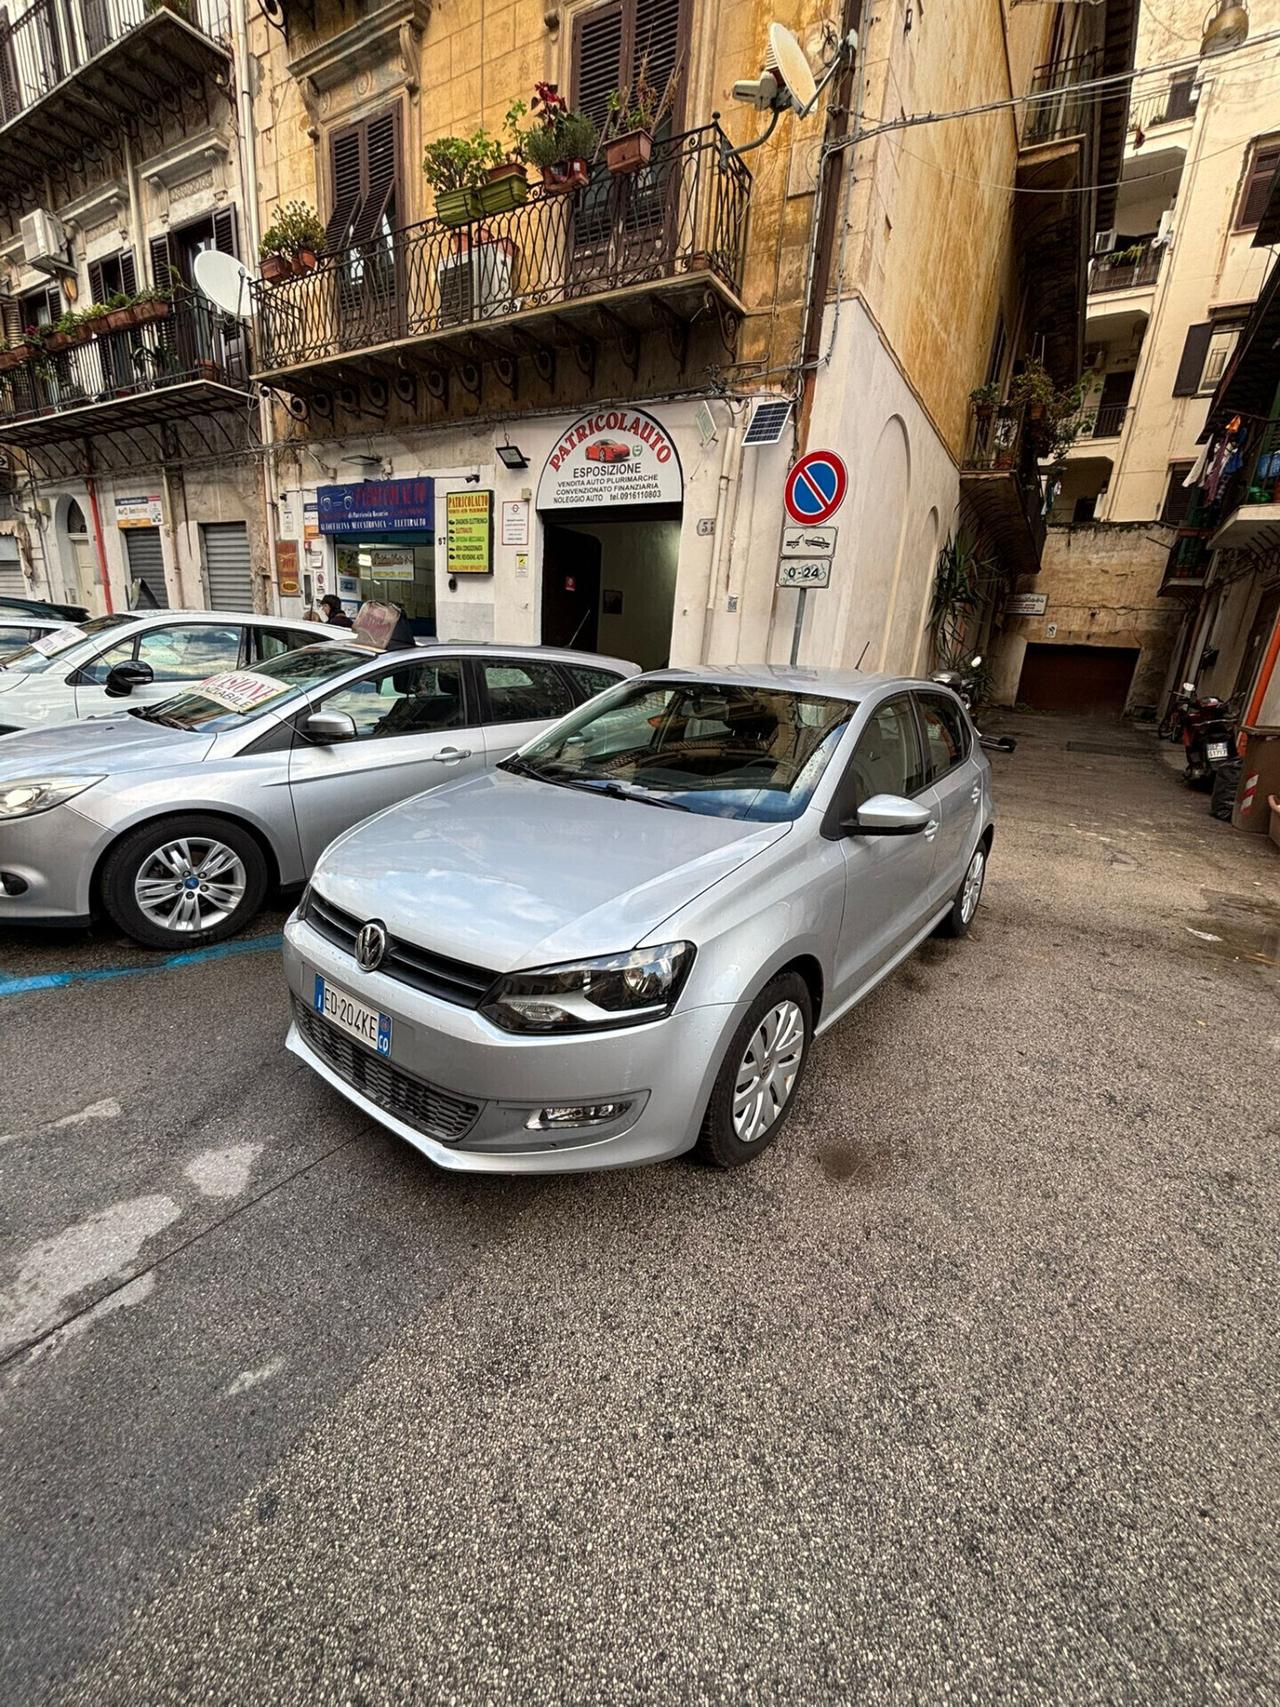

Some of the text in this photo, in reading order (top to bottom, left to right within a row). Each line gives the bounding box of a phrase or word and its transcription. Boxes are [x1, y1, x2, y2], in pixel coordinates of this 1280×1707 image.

[549, 412, 671, 472] PATRICOLAUTO
[573, 462, 641, 479] ESPOSIZIONE
[557, 480, 585, 488] VENDITA
[606, 474, 658, 484] PLURIMARCHE
[556, 483, 659, 495] CONVENZIONATO FINANZIARIA
[553, 496, 585, 504] NOLEGGIO
[587, 494, 603, 502] AUTO
